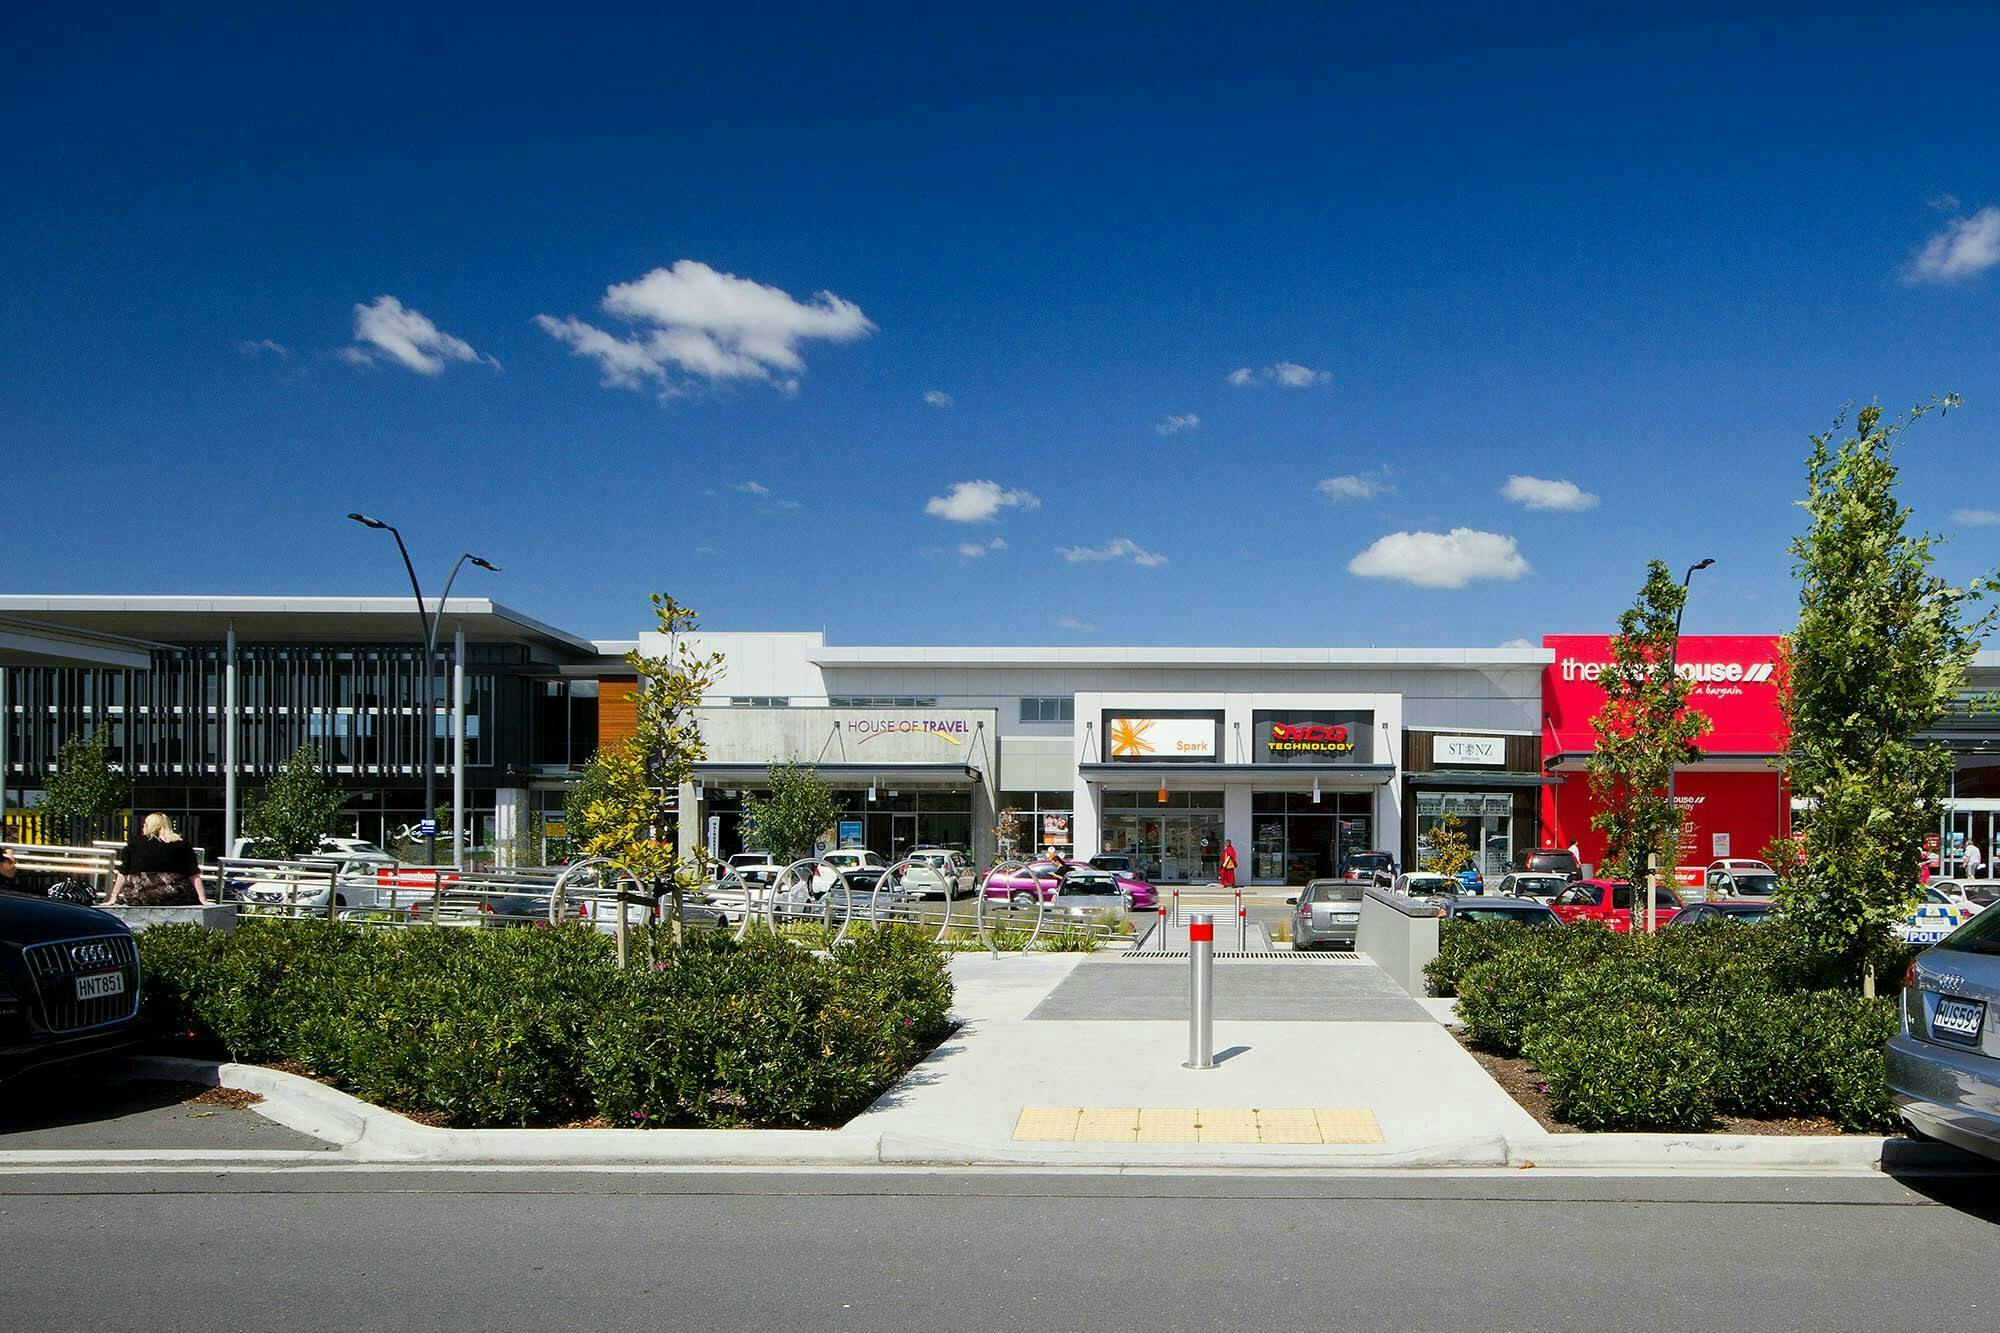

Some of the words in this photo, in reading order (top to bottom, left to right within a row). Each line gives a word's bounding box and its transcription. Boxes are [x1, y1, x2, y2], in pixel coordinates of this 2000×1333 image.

[1705, 685, 1743, 699] bargain
[848, 720, 895, 733] HOUSE
[899, 720, 919, 733] OF
[922, 720, 969, 733] TRAVEL
[1176, 740, 1208, 752] Spark
[1268, 742, 1354, 752] TECHNOLOGY
[1449, 743, 1493, 755] STNZ
[1910, 932, 1949, 942] POLIC
[79, 975, 122, 997] HNT851
[1936, 1003, 1982, 1031] HUS593
